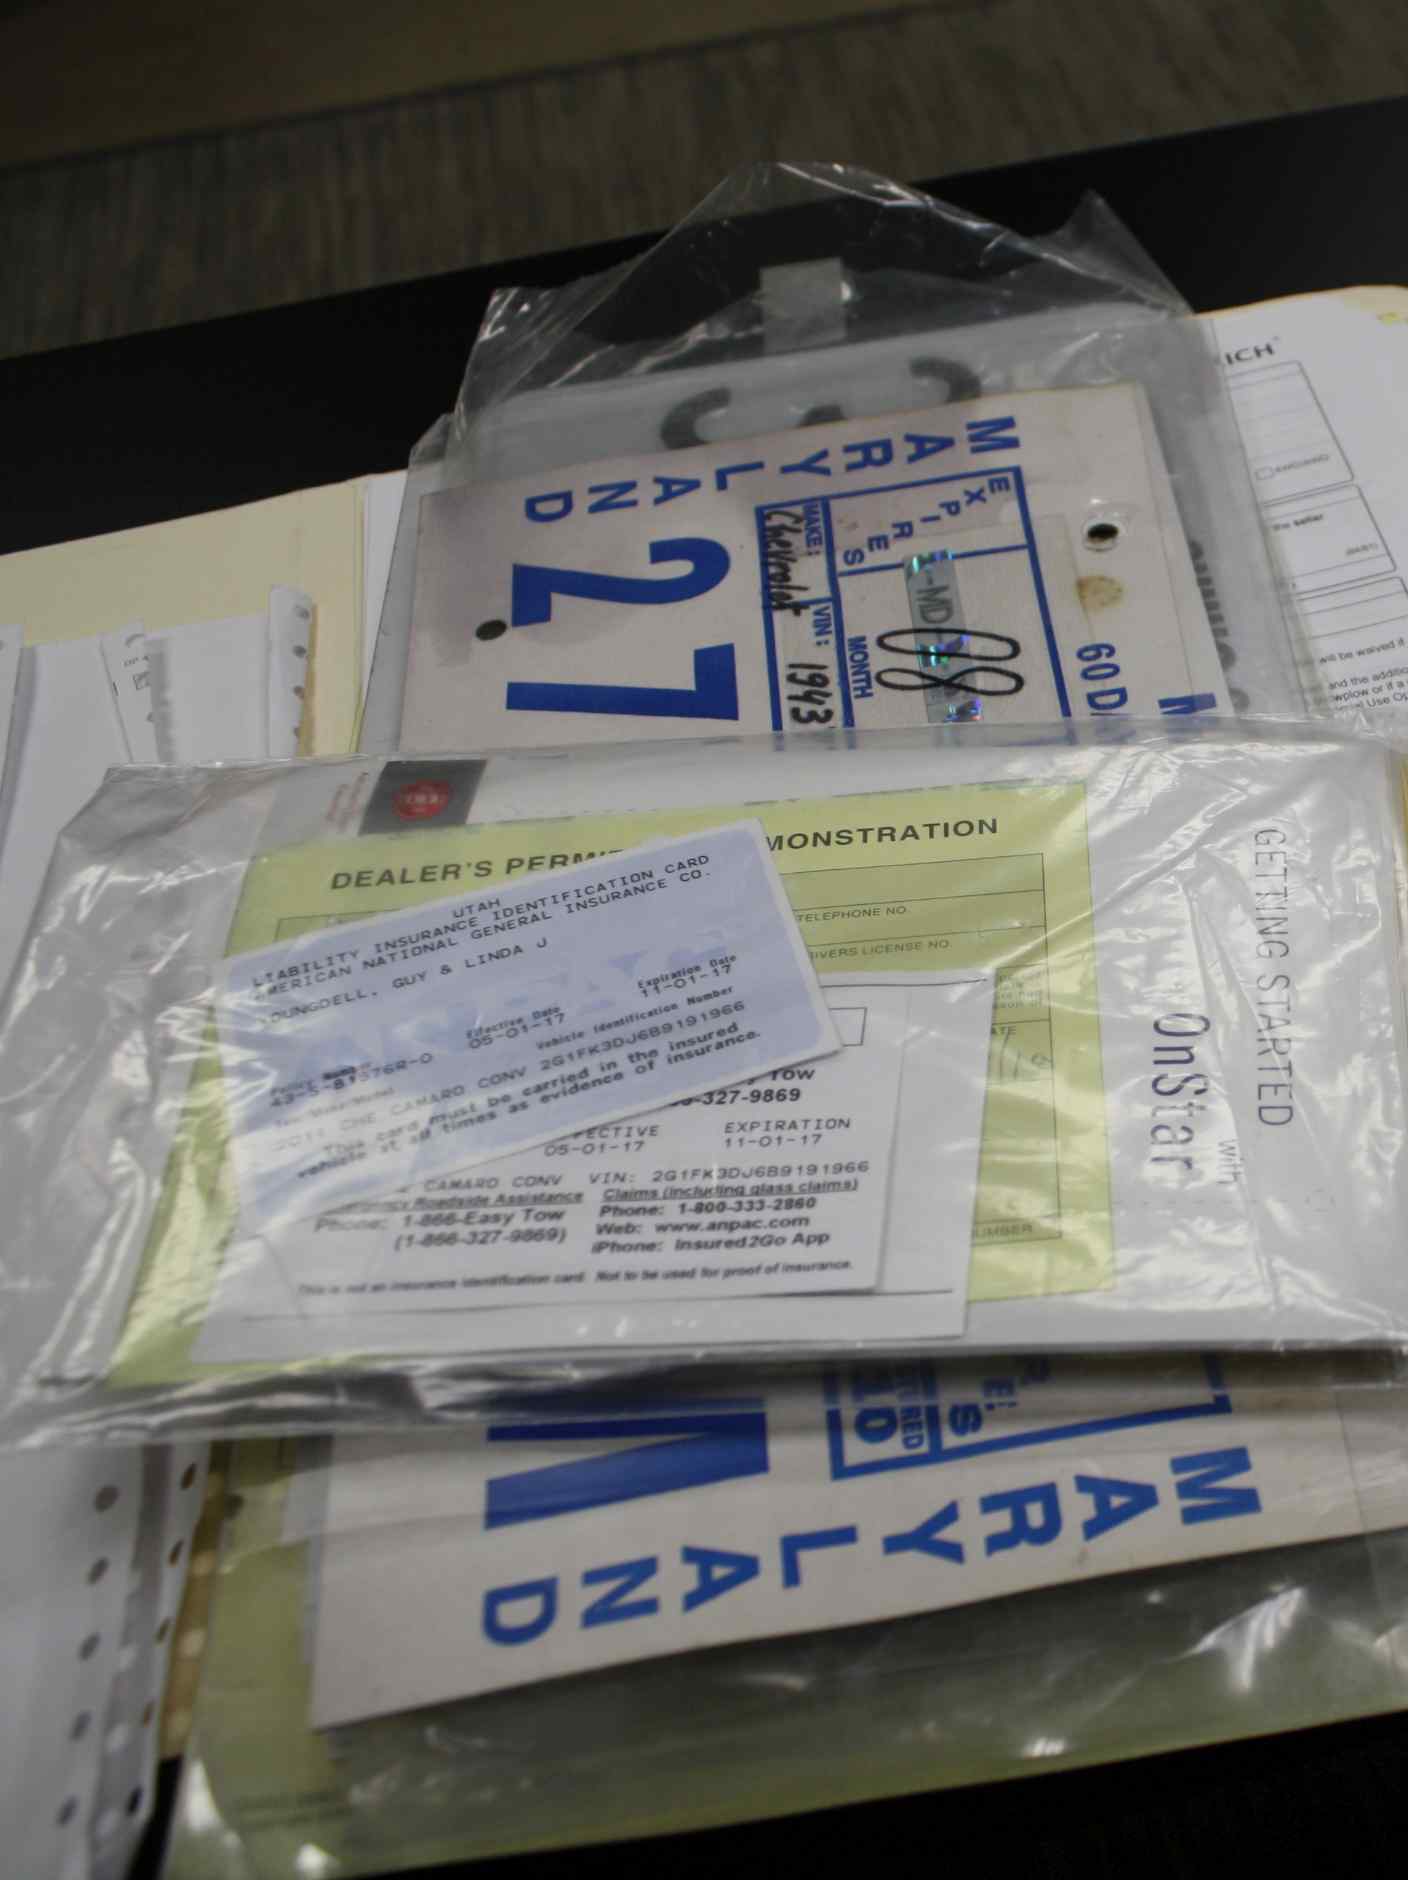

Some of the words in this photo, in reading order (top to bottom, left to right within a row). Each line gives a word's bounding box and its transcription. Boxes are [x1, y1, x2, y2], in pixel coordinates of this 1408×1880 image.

[1225, 343, 1276, 365] ICH
[847, 635, 874, 700] MONTH
[1076, 642, 1120, 681] 60
[765, 817, 998, 852] MONSTRATION
[330, 860, 493, 890] DEALER'S
[506, 848, 623, 875] PERM
[253, 949, 360, 987] LIABILITY
[374, 916, 478, 953] INSURANCE
[493, 869, 653, 920] IDENTIFICATION
[664, 855, 710, 875] CARD
[362, 937, 458, 970] NATIONAL
[470, 911, 553, 940] GENERAL
[565, 878, 668, 915] INSURANCE
[453, 898, 501, 918] UTAH
[795, 907, 881, 923] TELEPHONE
[392, 971, 428, 989] GUY
[464, 945, 523, 968] LINDA
[536, 937, 548, 949] J
[521, 1068, 591, 1098] carried
[626, 1047, 660, 1067] the
[668, 1021, 741, 1053] insured
[1256, 973, 1295, 1126] STARTED
[476, 1066, 528, 1090] CONV
[539, 1070, 625, 1105] evidence
[634, 1059, 656, 1077] of
[1151, 1012, 1210, 1171] OnStar
[574, 1124, 660, 1140] ECTIVE
[723, 1117, 851, 1134] EXPIRATION
[511, 1174, 563, 1189] CONV
[521, 1207, 567, 1222] Tow
